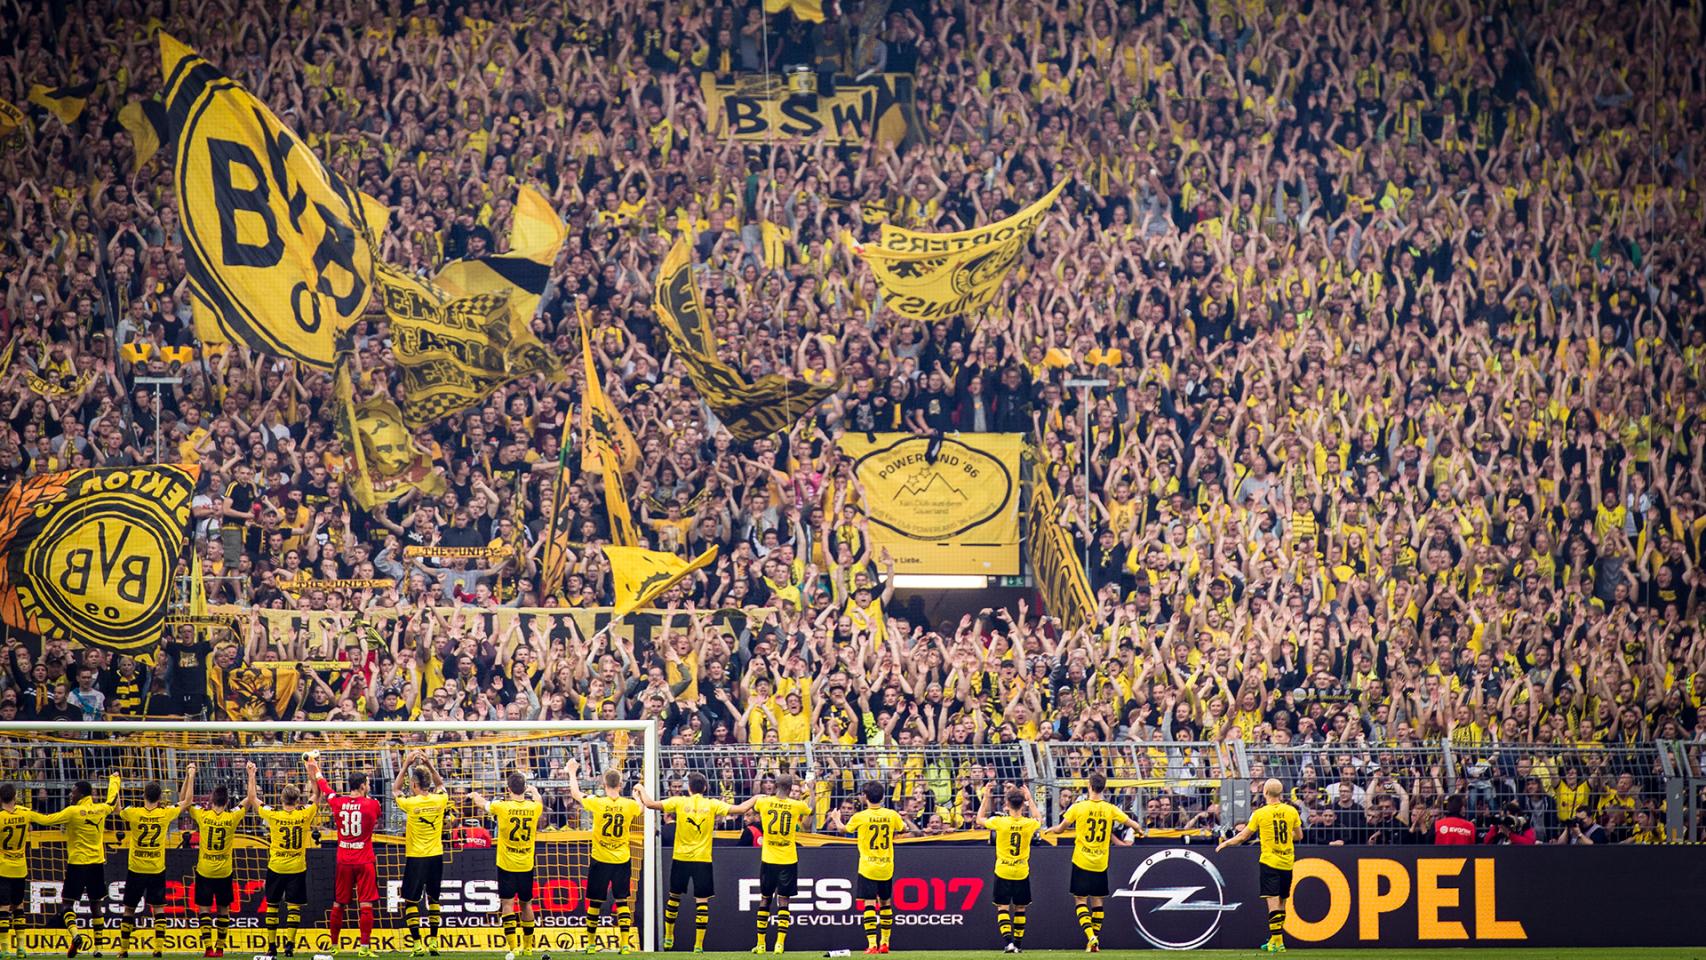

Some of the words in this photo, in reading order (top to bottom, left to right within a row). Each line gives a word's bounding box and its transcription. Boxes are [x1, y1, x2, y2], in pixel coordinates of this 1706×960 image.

[725, 90, 873, 138] BSW
[879, 453, 959, 479] POWERND
[963, 461, 980, 478] '86
[423, 547, 447, 555] THE
[459, 547, 496, 556] UNITY
[339, 811, 362, 836] 38
[509, 817, 533, 842] 25
[602, 813, 624, 838] 28
[767, 809, 792, 836] 20
[1085, 818, 1107, 843] 33
[1273, 820, 1288, 844] 18
[3, 824, 26, 850] 27
[138, 824, 161, 847] 22
[208, 827, 226, 850] 13
[279, 826, 303, 849] 30
[869, 824, 890, 850] 23
[1009, 832, 1021, 856] 9
[1145, 850, 1207, 868] OPEL
[856, 878, 984, 911] 017
[1283, 857, 1528, 942] OPEL
[895, 915, 963, 926] SOCCER
